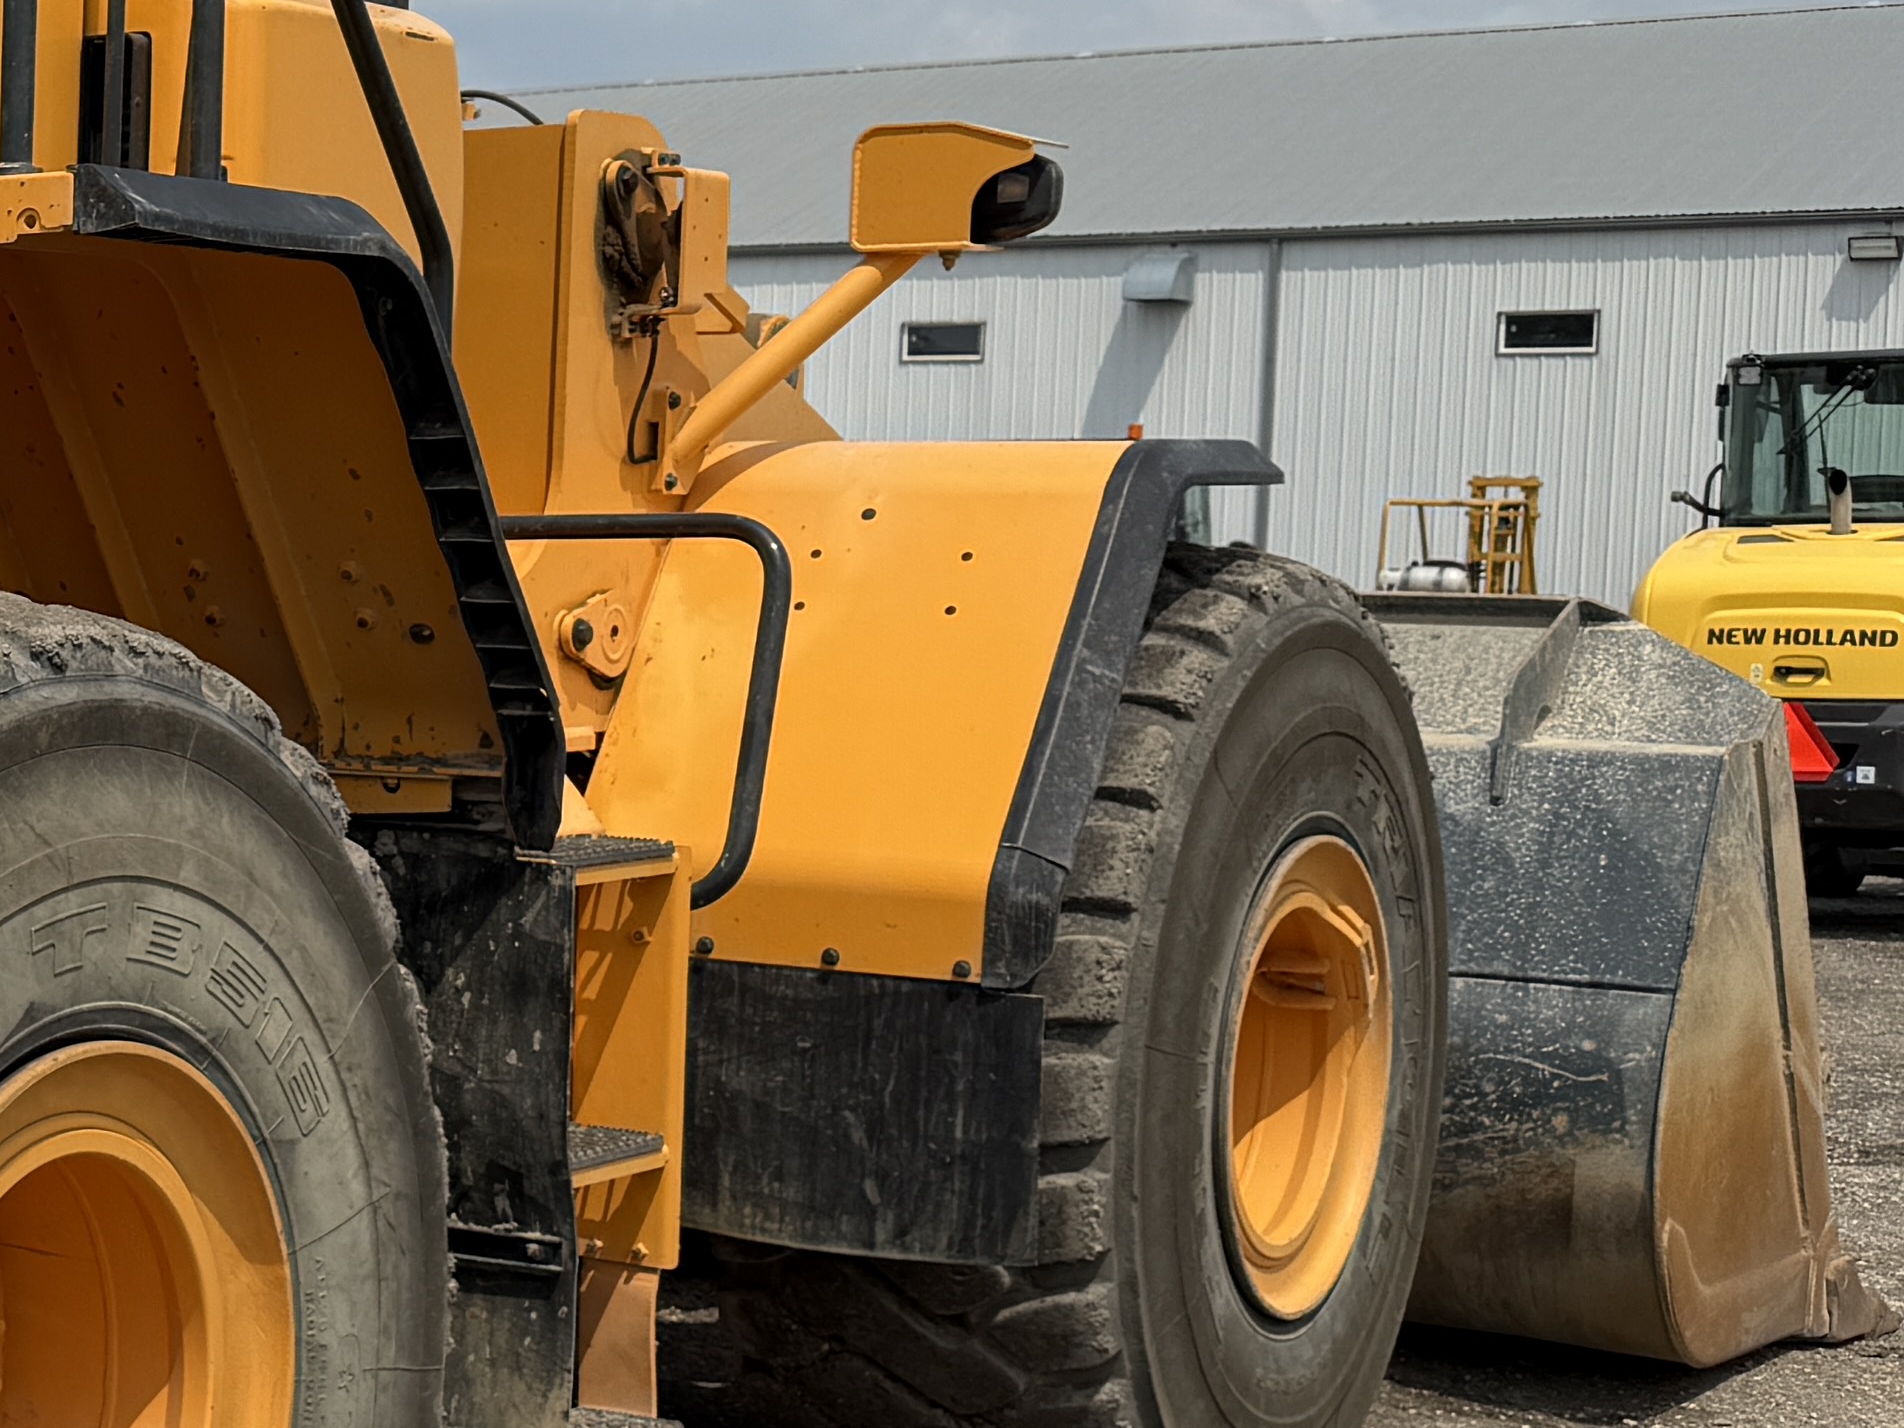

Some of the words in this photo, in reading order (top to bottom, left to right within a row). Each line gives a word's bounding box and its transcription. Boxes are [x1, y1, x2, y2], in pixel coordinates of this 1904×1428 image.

[1706, 627, 1767, 646] NEW
[1772, 627, 1899, 648] HOLLAND
[30, 901, 331, 1137] TB516
